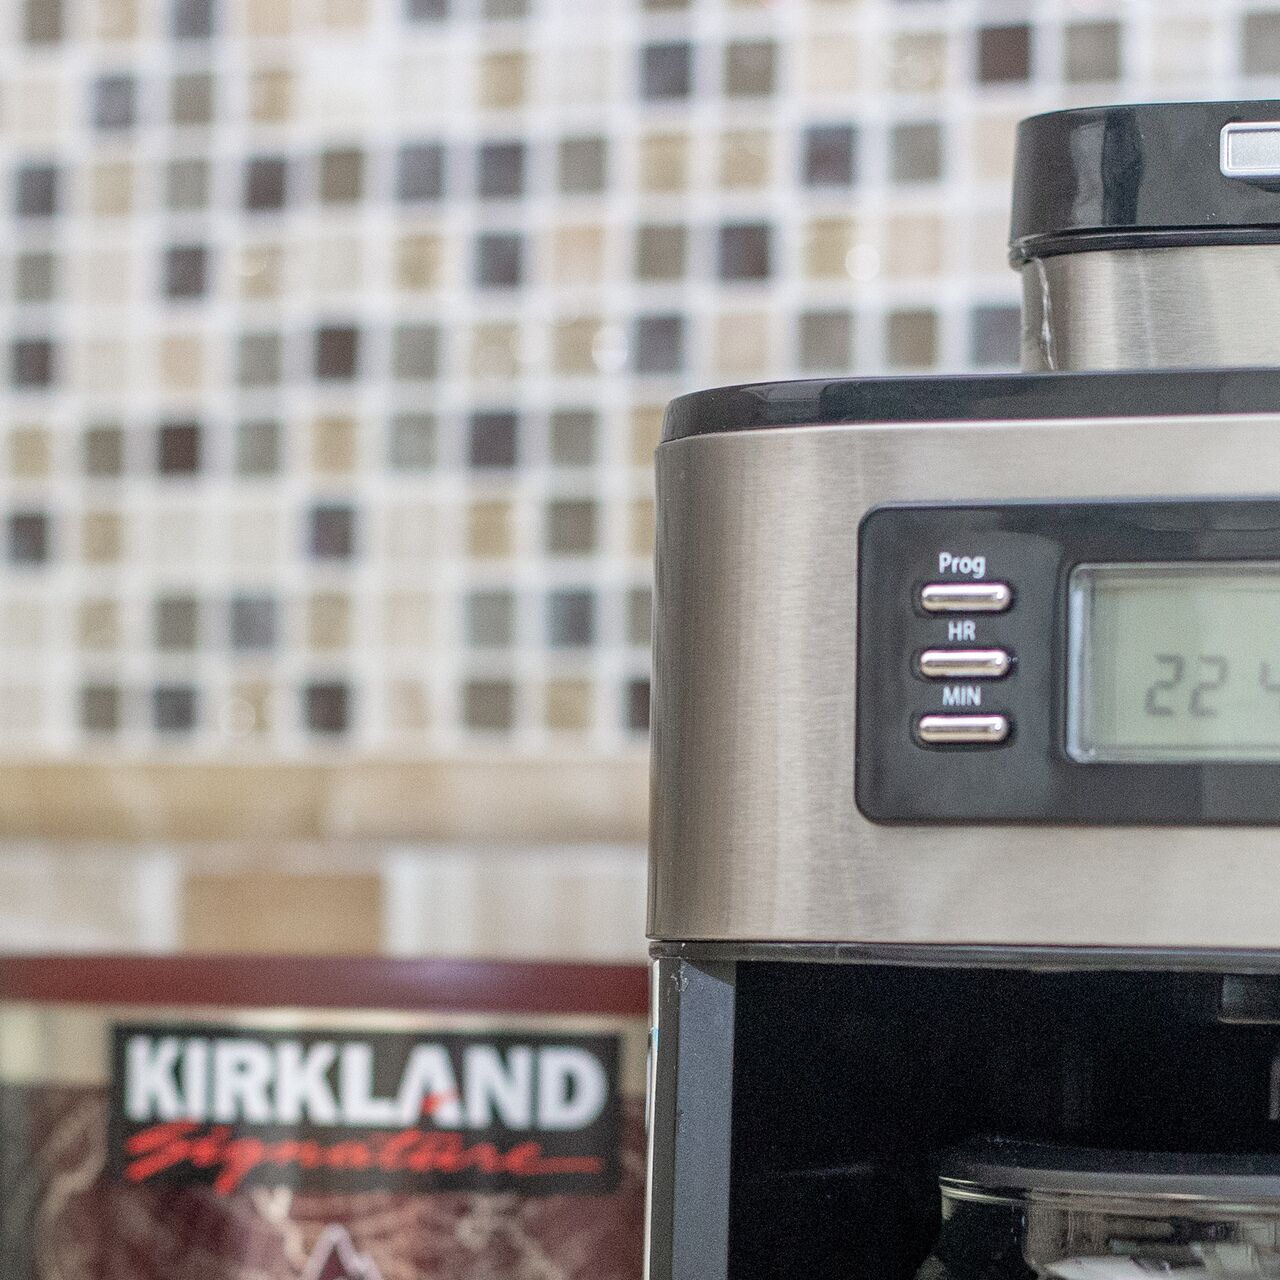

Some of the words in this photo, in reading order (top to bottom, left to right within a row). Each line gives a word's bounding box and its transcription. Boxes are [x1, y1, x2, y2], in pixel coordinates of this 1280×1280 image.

[938, 552, 987, 579] Prog
[947, 620, 976, 642] HR
[942, 685, 982, 707] MIN
[123, 1033, 611, 1132] KIRKLAND
[122, 1119, 604, 1195] Signature
